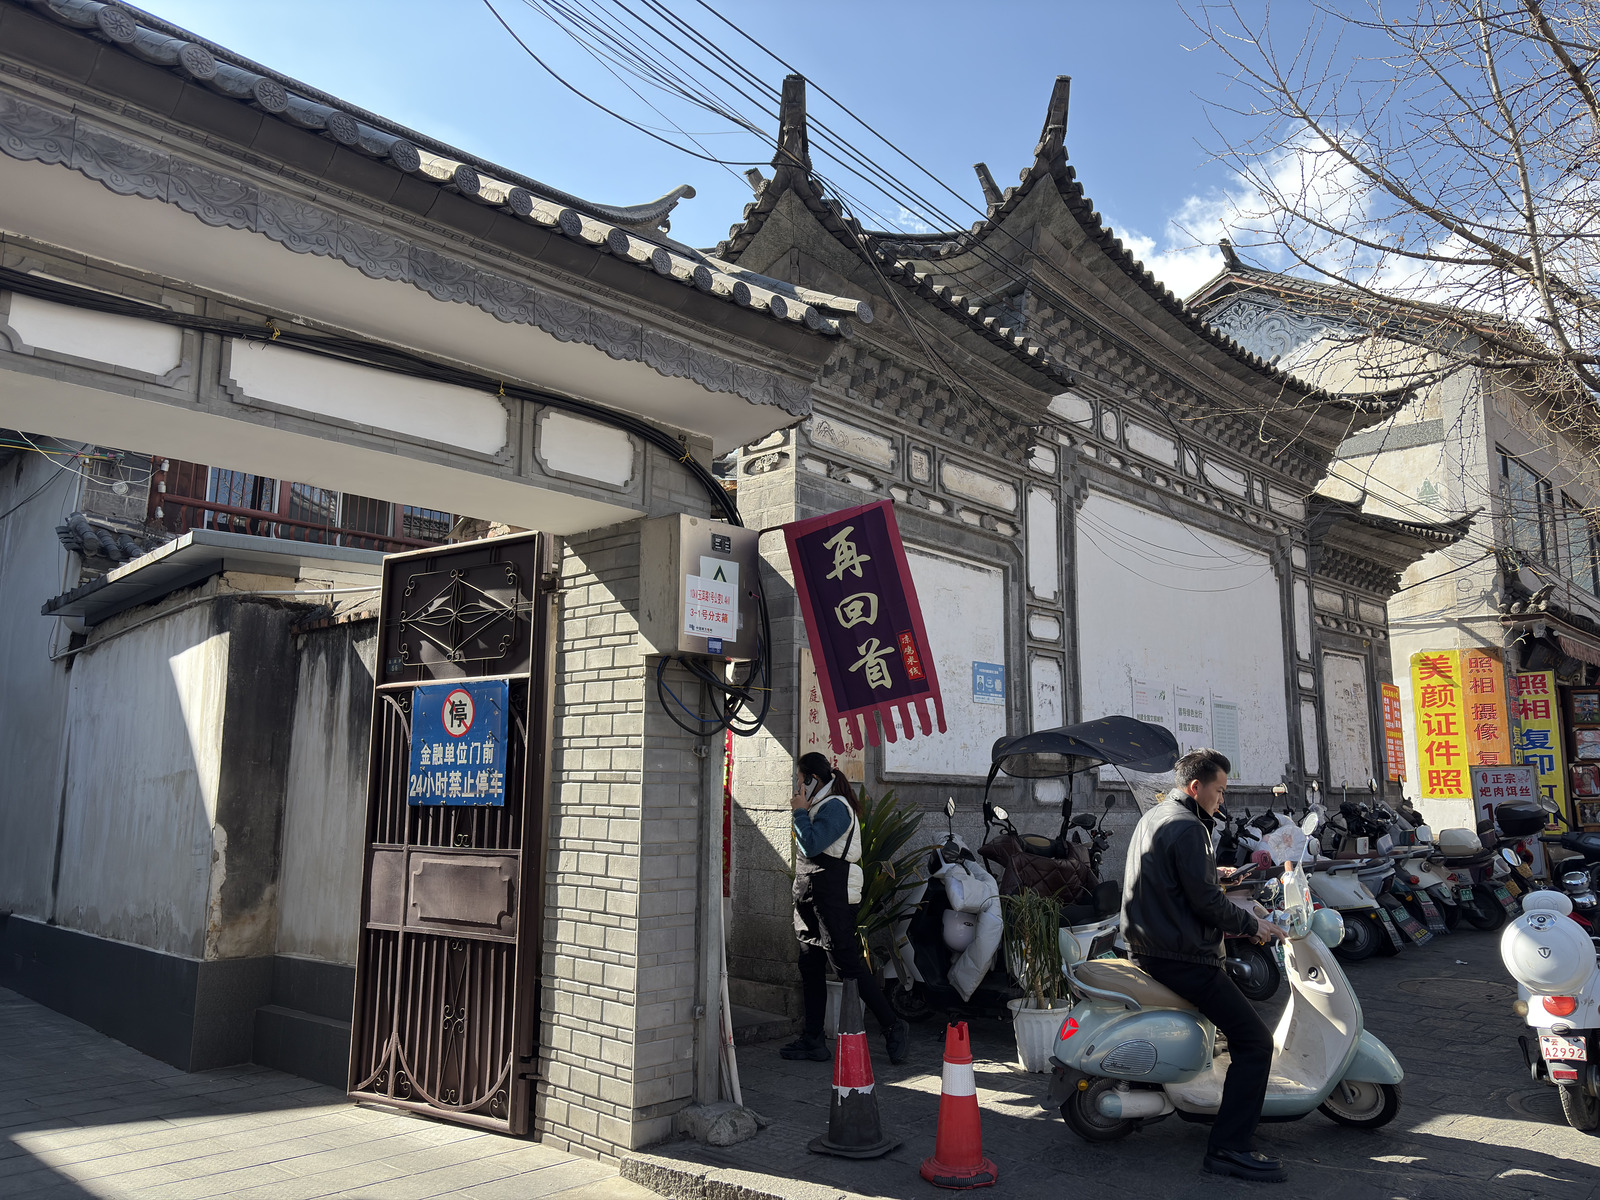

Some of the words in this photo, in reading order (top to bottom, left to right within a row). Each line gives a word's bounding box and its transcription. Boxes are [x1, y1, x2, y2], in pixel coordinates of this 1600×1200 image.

[690, 608, 728, 623] 3-1号分支箱
[822, 526, 895, 690] 再回首
[449, 700, 467, 728] 停
[1418, 654, 1464, 795] 美颜证件照
[420, 740, 494, 765] 金融单位门前
[410, 769, 503, 798] 24小时禁止停车
[1491, 773, 1516, 784] 正宗
[1545, 1047, 1584, 1059] A2992
